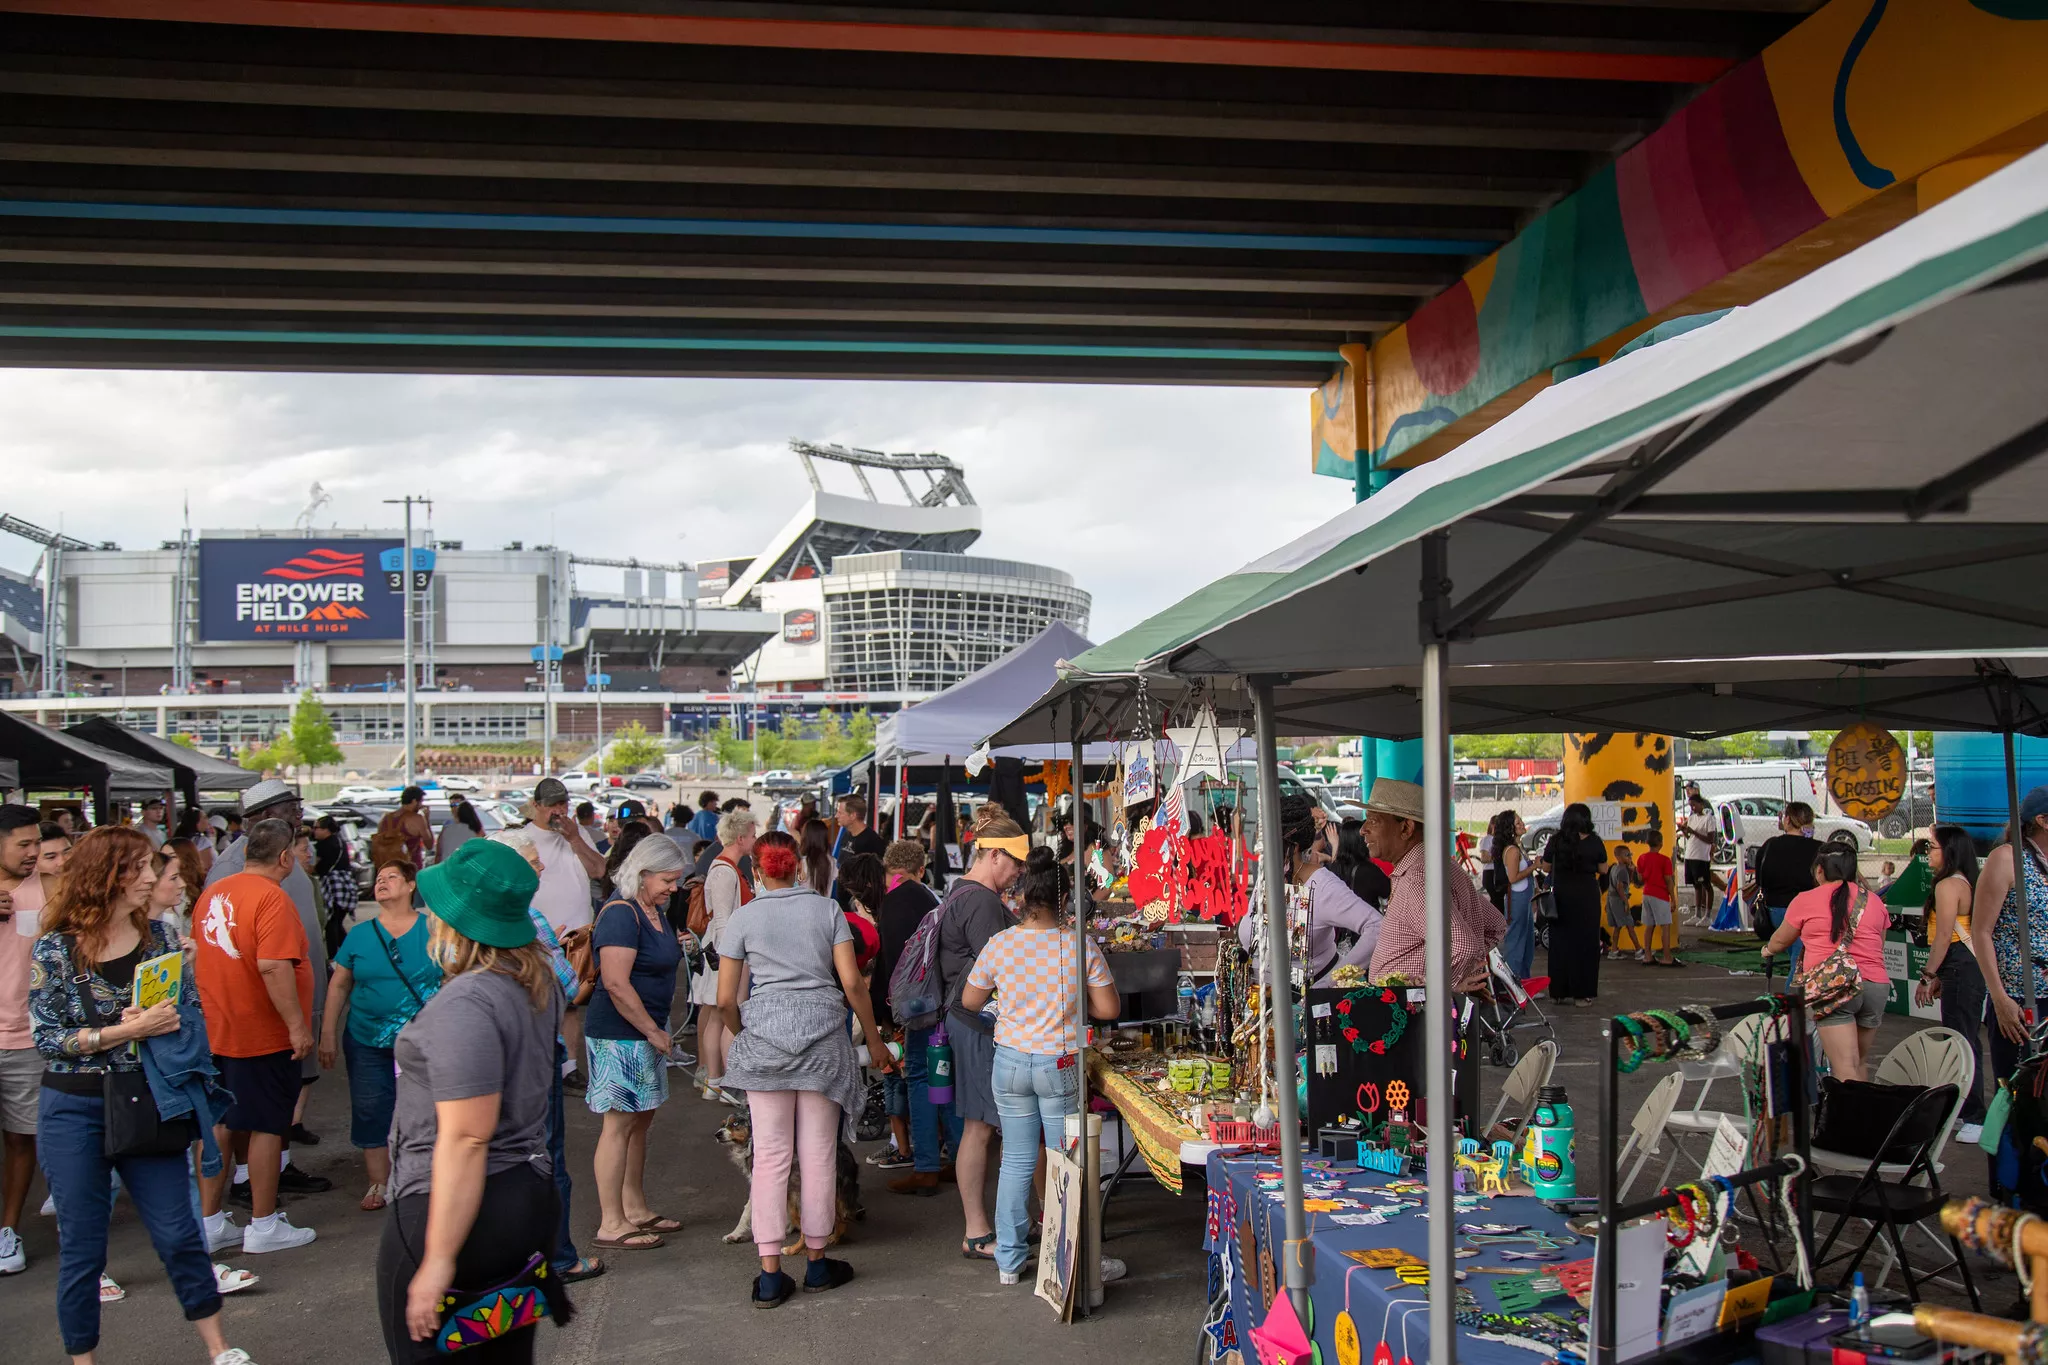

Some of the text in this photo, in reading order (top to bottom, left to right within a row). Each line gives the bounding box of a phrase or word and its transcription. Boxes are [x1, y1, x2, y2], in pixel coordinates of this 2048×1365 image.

[390, 572, 427, 587] 3 3
[236, 583, 365, 602] EMPOWER
[236, 602, 308, 621] FIELD
[254, 624, 349, 633] AT MILE HIGH
[536, 661, 558, 670] 2 2
[1835, 748, 1860, 767] BEE
[1832, 777, 1900, 799] CROSSING
[1913, 950, 1930, 958] TRASH
[1357, 1140, 1403, 1176] Family
[1223, 1320, 1237, 1347] A
